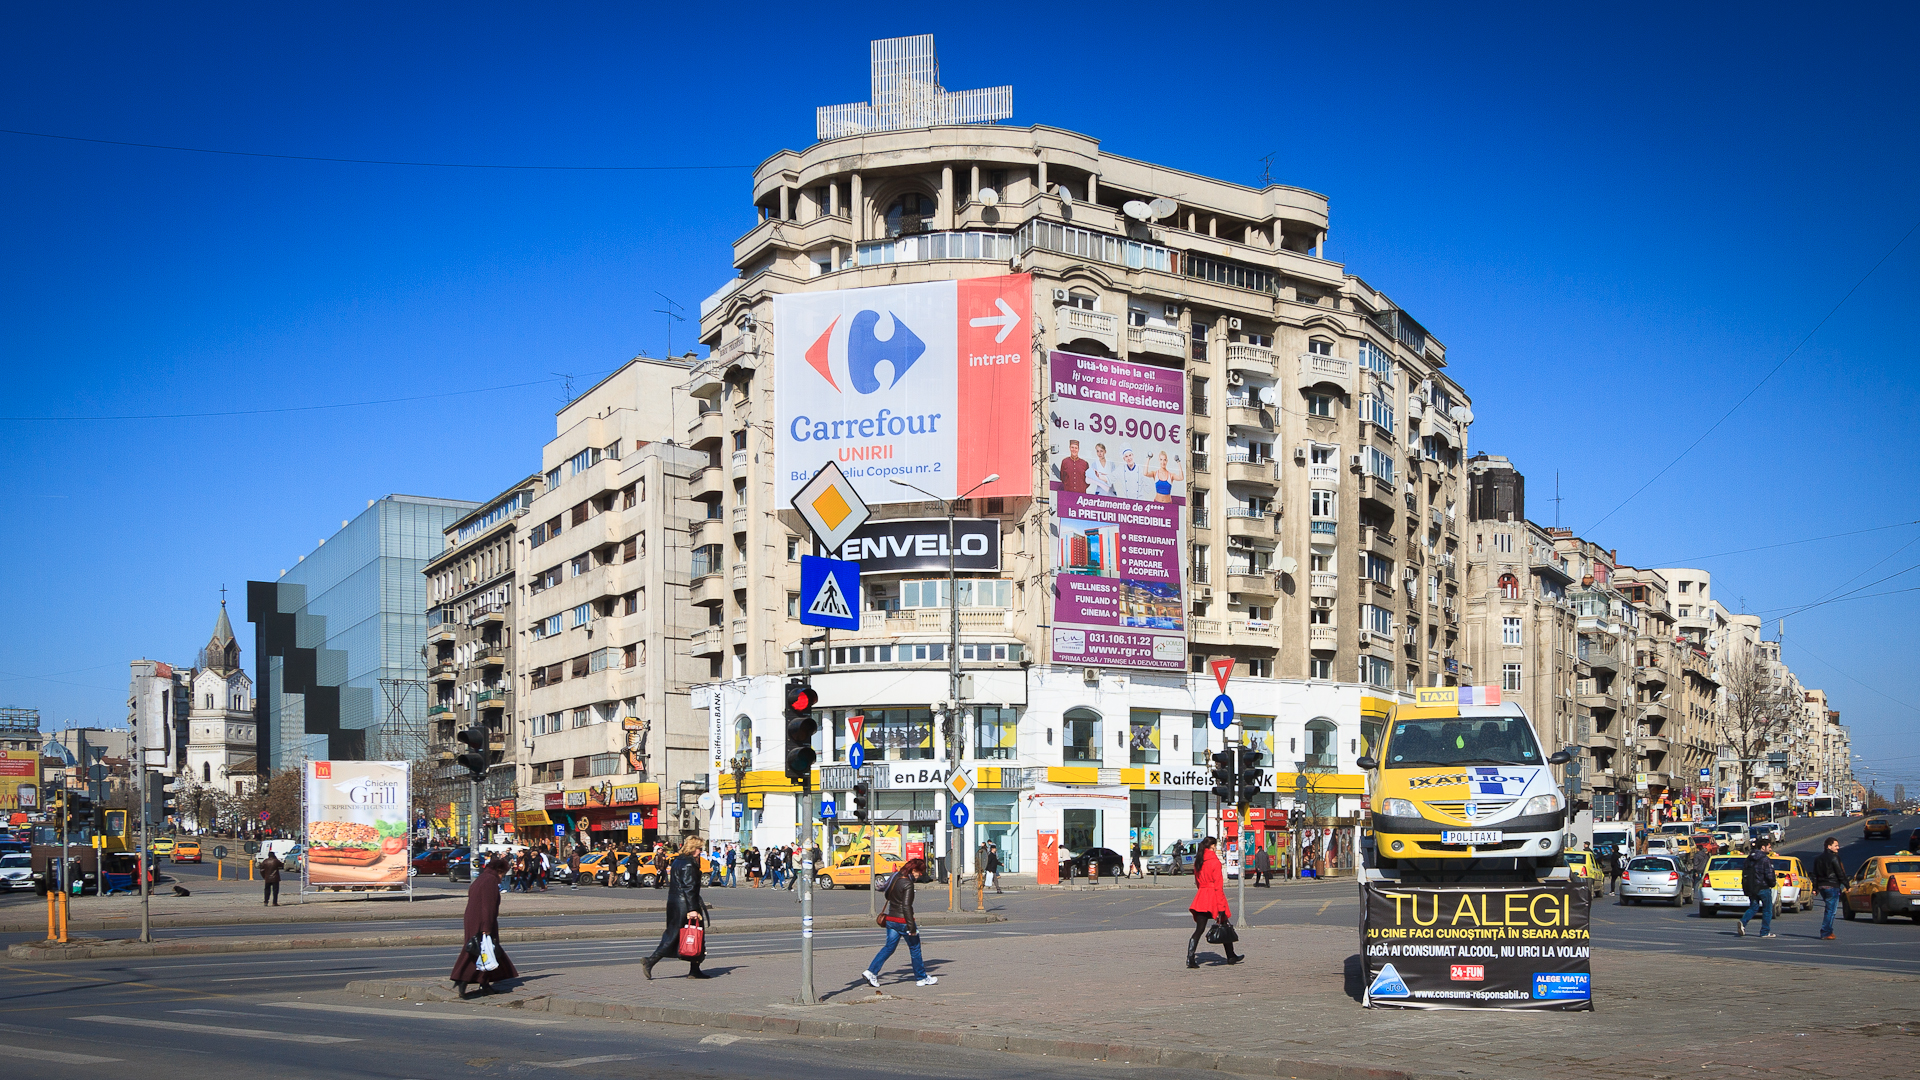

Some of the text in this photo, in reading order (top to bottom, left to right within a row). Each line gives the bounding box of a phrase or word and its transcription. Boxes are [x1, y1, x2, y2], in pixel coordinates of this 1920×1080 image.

[969, 352, 1021, 366] intrare
[1111, 365, 1131, 376] bine
[1133, 368, 1142, 378] la
[1144, 370, 1156, 380] ei!
[1082, 374, 1095, 383] vor
[1096, 376, 1108, 385] sta
[1110, 378, 1117, 386] la
[1055, 382, 1180, 411] RIN Grand Residence
[790, 408, 941, 442] Carrefour
[1054, 416, 1070, 428] de
[1074, 419, 1085, 431] la
[838, 444, 893, 462] UNIRII
[791, 462, 941, 481] Bd. Celiu Coposu nr. 2
[1076, 496, 1130, 511] Apartamente
[1132, 502, 1143, 512] de
[1068, 508, 1076, 518] la
[1118, 514, 1172, 528] INCREDIBILE
[1128, 534, 1176, 546] RESTAURANT
[1128, 546, 1164, 557] SECURITY
[1128, 559, 1163, 569] PARCARE
[1070, 582, 1110, 593] WELLNESS
[1076, 595, 1110, 605] FUNLAND
[1081, 608, 1110, 618] CINEMA
[1089, 633, 1151, 646] 031.106.11.22
[1088, 645, 1152, 657] www.rgr.ro
[1138, 660, 1179, 668] DEZVOLTATOR
[1422, 692, 1453, 701] TAXI
[714, 718, 722, 760] Raiffeisen
[1164, 770, 1218, 785] Raiffeis
[350, 786, 395, 804] Grill
[1450, 832, 1496, 842] POLITAXI
[1386, 894, 1569, 926] TU ALEGI
[1381, 928, 1406, 938] CINE
[1410, 928, 1434, 938] FACI
[1508, 926, 1520, 938] ÎN
[1522, 929, 1559, 938] SEARA
[1560, 930, 1590, 938] ASTA
[1391, 945, 1400, 956] AI
[1402, 945, 1456, 957] CONSUMAT
[1458, 946, 1498, 958] ALCOOL,
[1500, 946, 1515, 958] NU
[1517, 946, 1540, 958] URCI
[1542, 946, 1555, 958] LA
[1556, 946, 1590, 958] VOLAN
[1452, 966, 1482, 977] 24-FUN
[1414, 990, 1529, 1000] www.consuma-responsabil.ro
